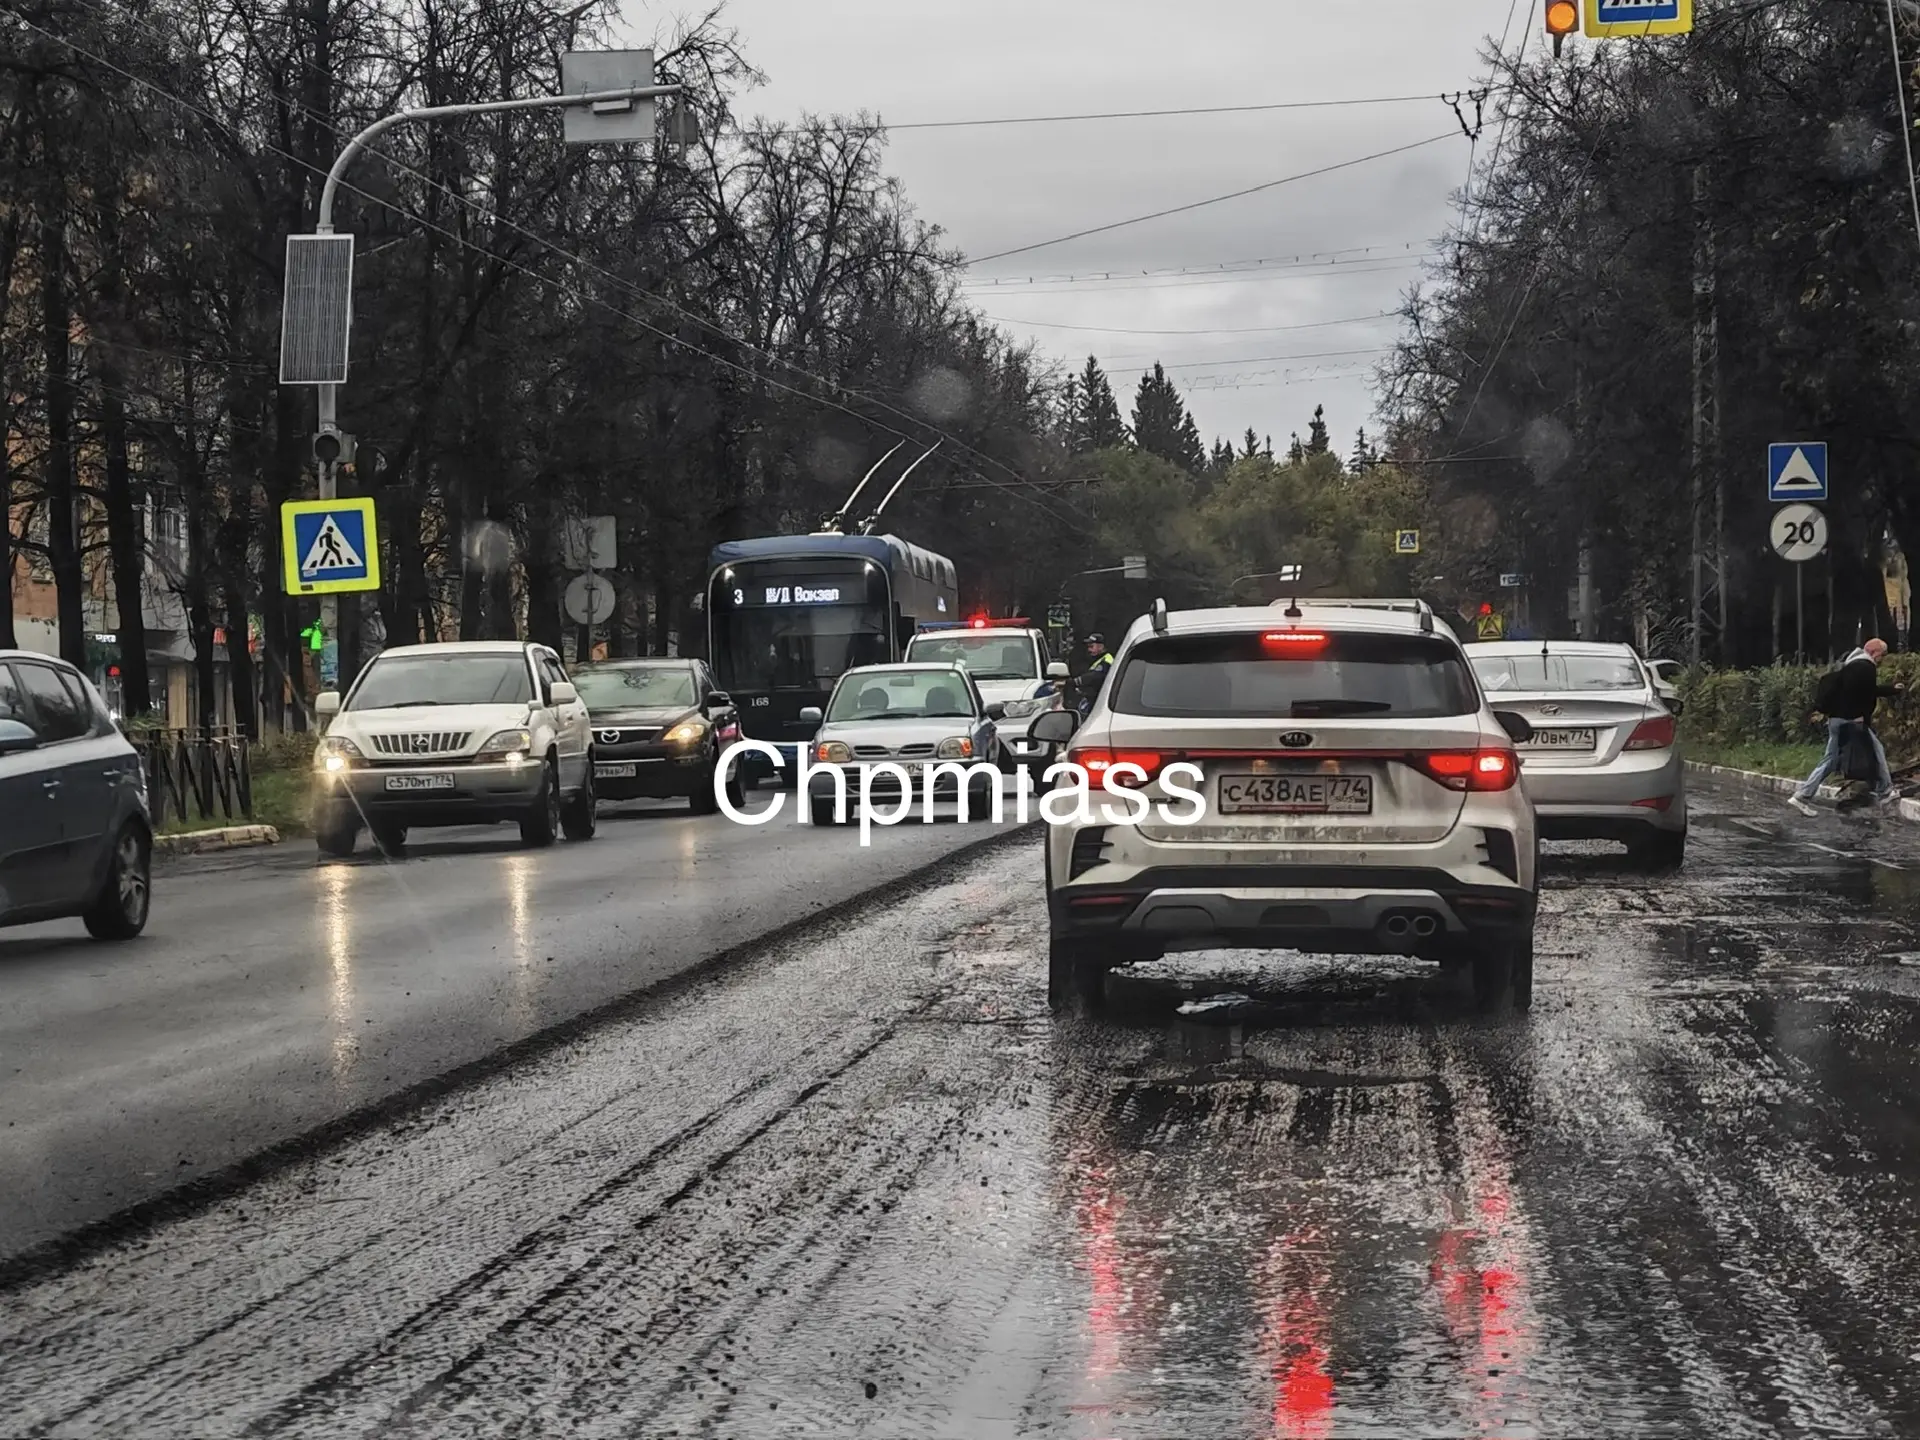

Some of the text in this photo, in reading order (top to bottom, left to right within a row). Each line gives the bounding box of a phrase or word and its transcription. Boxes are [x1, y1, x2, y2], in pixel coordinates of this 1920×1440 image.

[1784, 521, 1814, 544] 20
[734, 588, 743, 605] 3
[794, 586, 839, 602] Вокзал
[750, 696, 769, 707] 168
[1286, 733, 1307, 744] KIA
[1569, 730, 1591, 741] 774
[1228, 779, 1365, 802] С438АЕ 774
